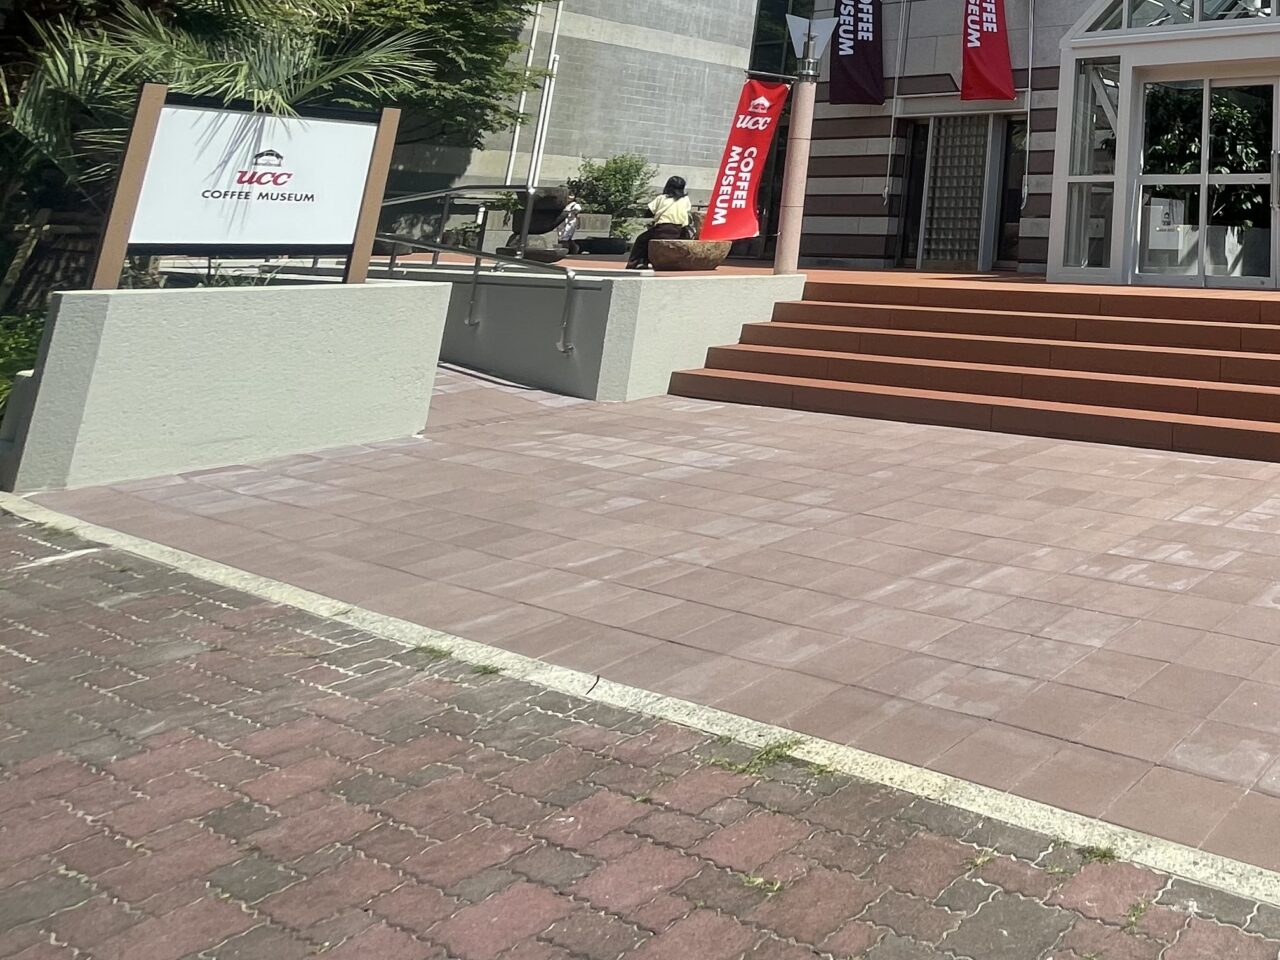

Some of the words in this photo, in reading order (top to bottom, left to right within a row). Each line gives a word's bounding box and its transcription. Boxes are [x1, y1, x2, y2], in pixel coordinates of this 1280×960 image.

[735, 114, 771, 131] UCC
[236, 170, 293, 186] UCC
[711, 145, 742, 226] MUSEUM
[731, 146, 757, 209] COFFEE
[201, 189, 251, 200] COFFEE
[257, 192, 315, 202] MUSEUM
